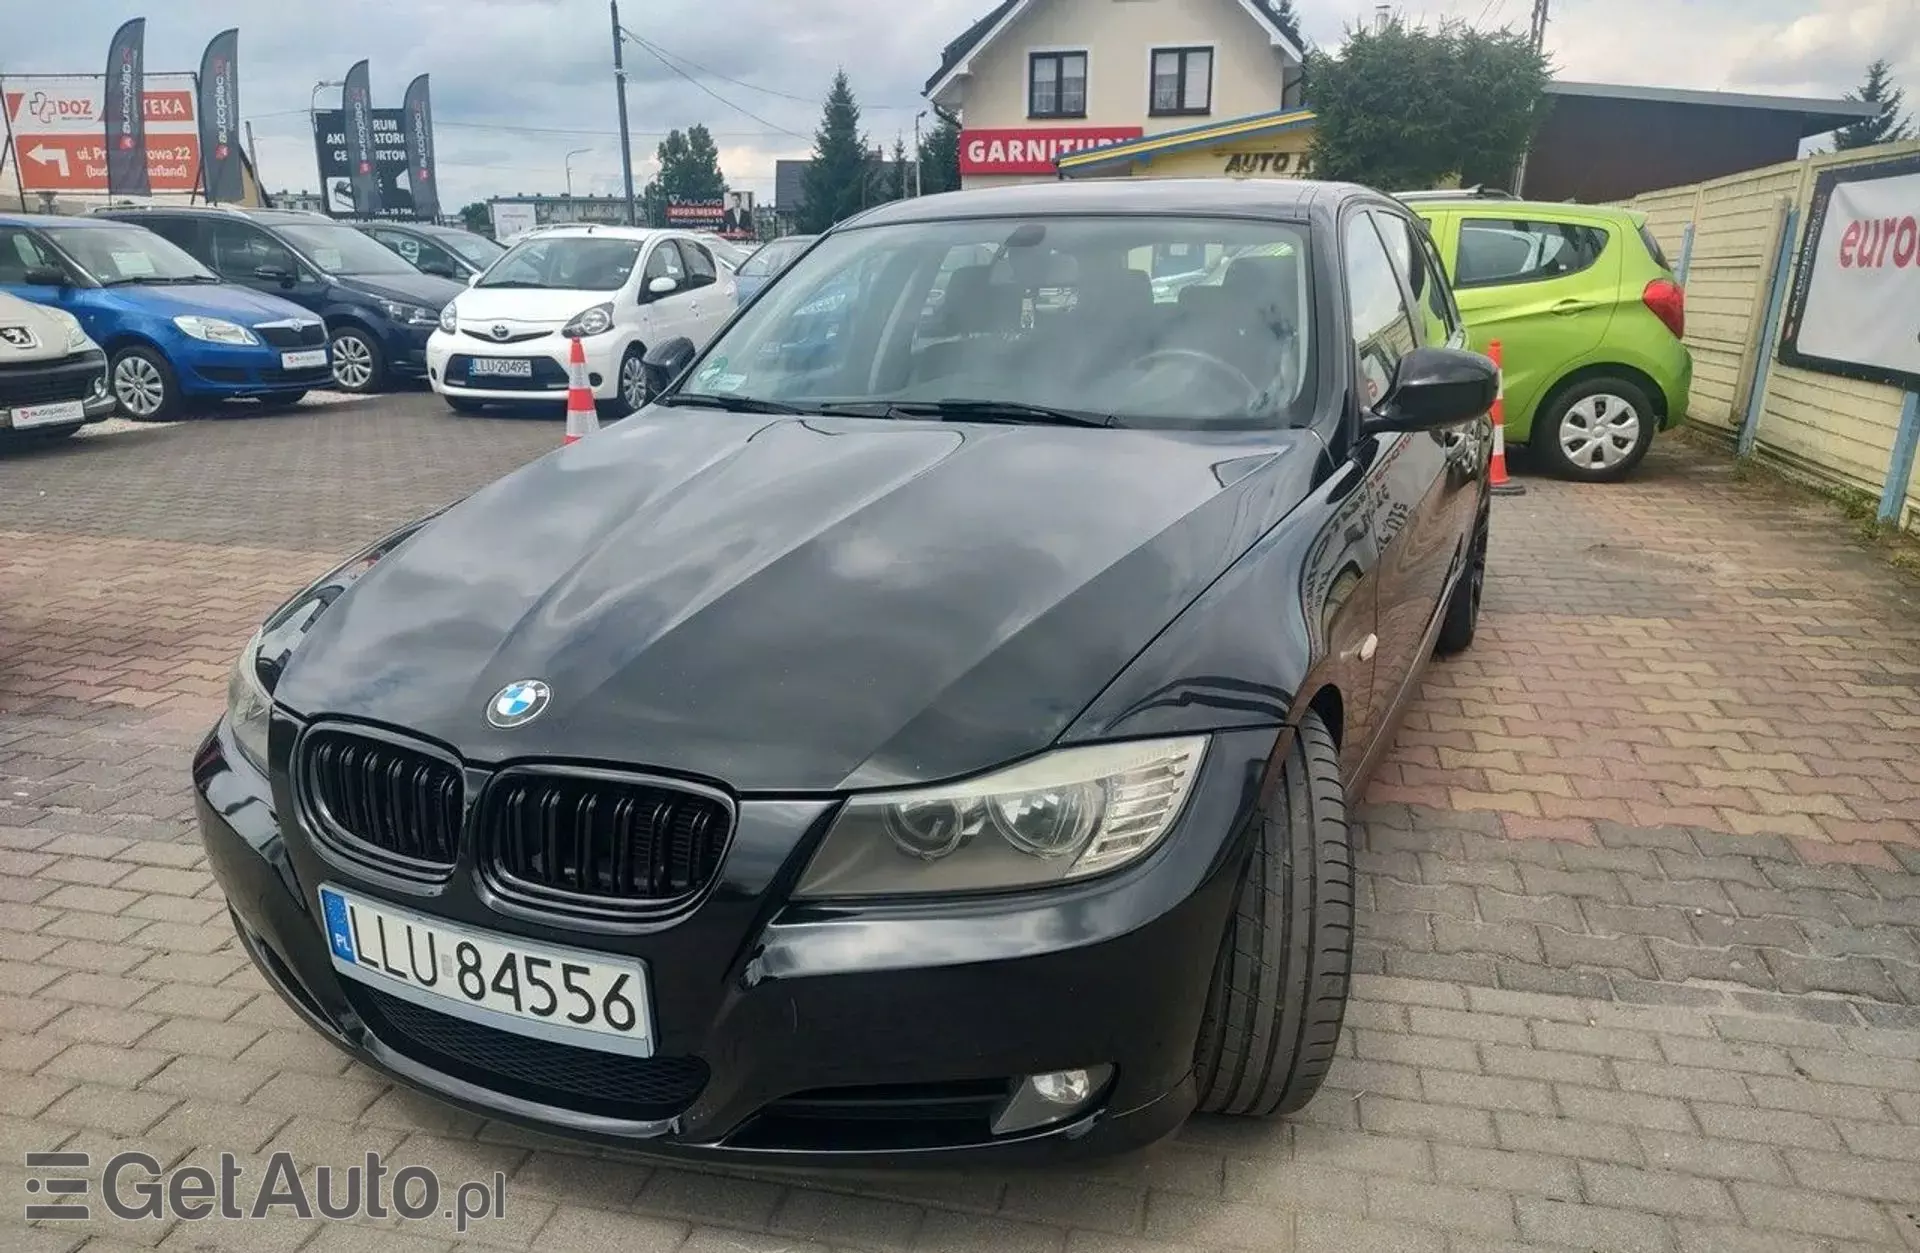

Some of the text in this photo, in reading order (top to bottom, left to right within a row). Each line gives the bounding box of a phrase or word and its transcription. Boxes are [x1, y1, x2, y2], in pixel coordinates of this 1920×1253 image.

[58, 100, 92, 115] DOZ
[76, 146, 92, 160] ul.
[174, 146, 191, 160] 22
[1224, 152, 1290, 174] AUTO
[349, 905, 637, 1032] LLU 84556
